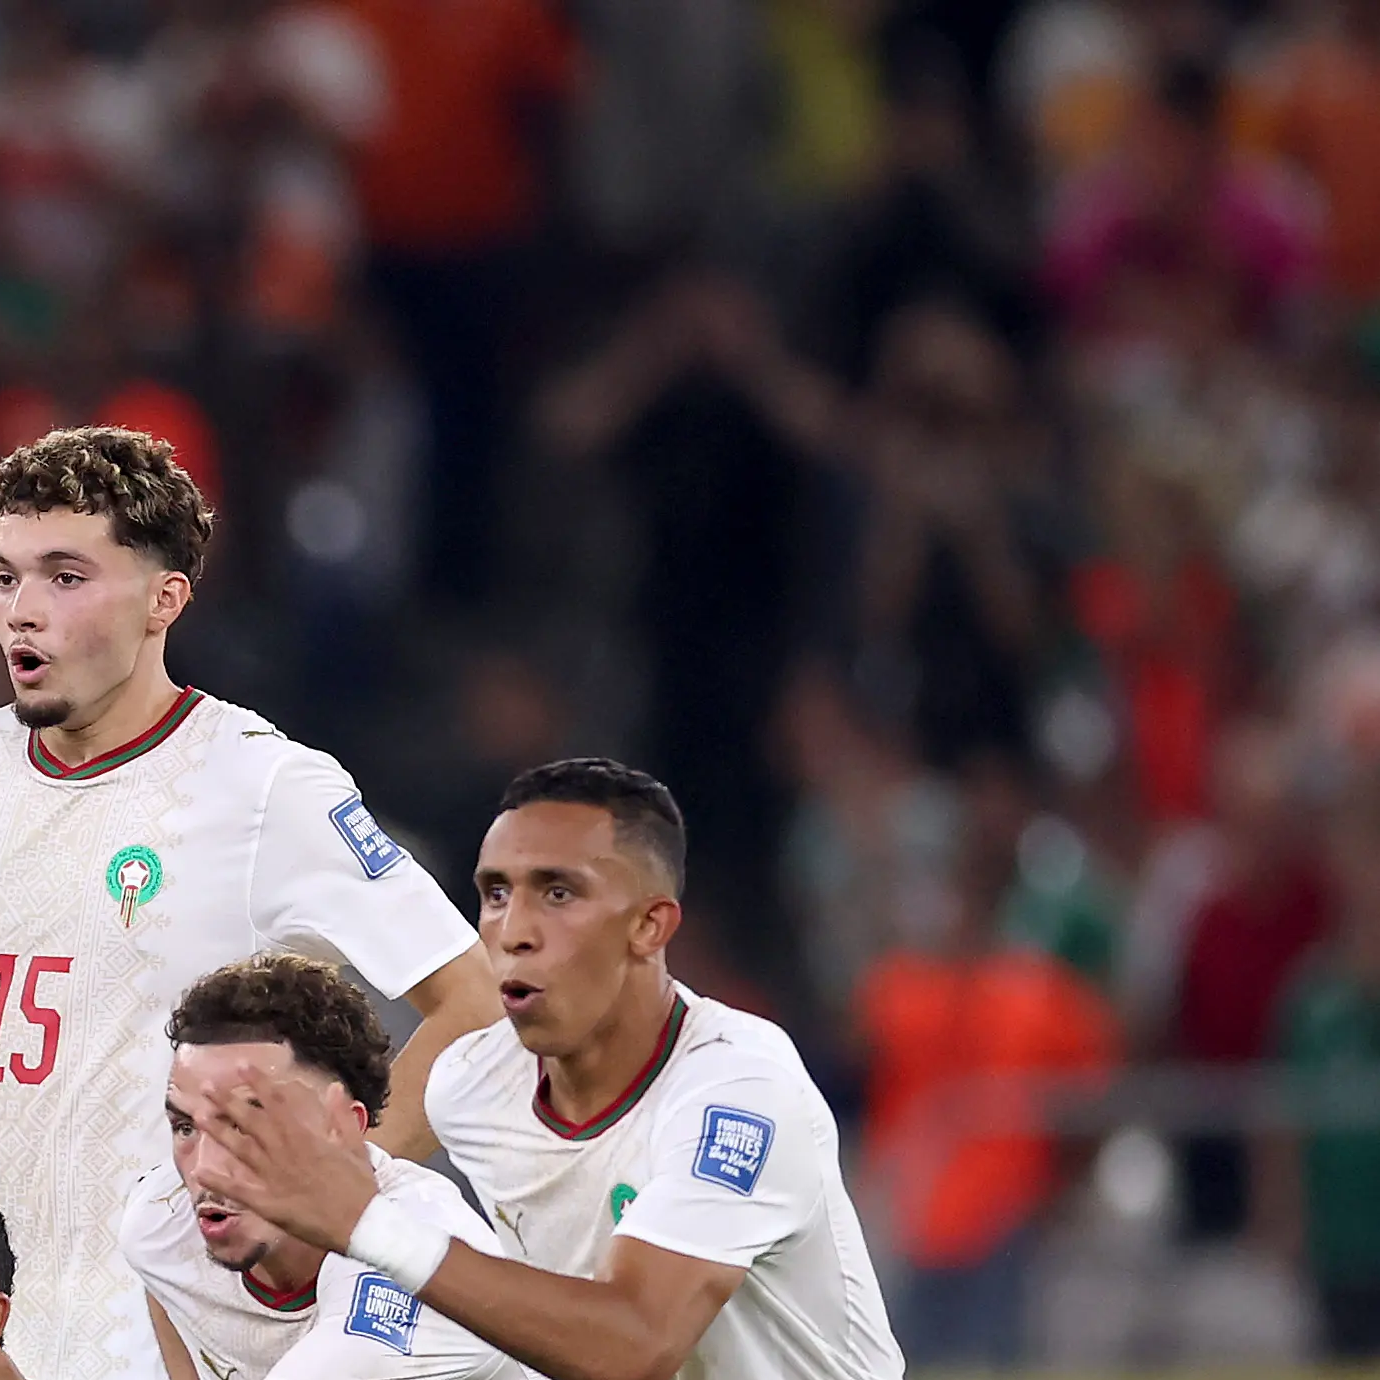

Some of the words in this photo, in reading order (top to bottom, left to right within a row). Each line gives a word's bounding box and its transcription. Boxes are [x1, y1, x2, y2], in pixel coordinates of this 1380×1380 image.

[716, 1117, 764, 1142] FOOTBALL
[707, 1144, 728, 1161] the
[713, 1129, 763, 1159] UNITES
[364, 1296, 410, 1323] UNITES
[368, 1284, 413, 1310] FOOTBALL
